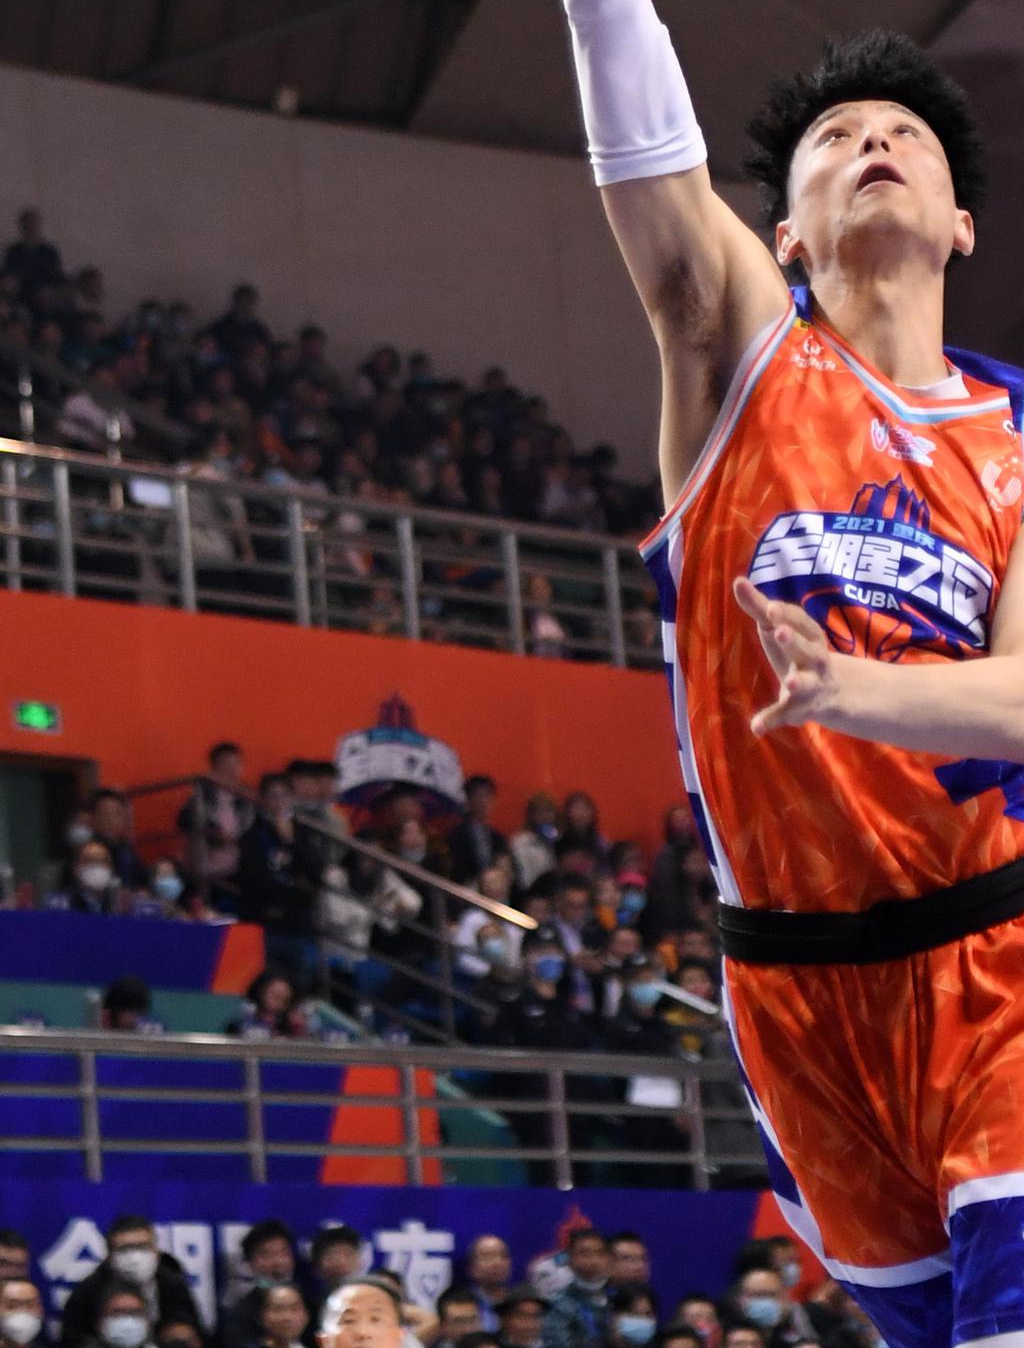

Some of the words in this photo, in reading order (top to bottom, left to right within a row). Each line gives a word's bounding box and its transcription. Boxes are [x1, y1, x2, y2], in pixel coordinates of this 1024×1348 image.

[832, 515, 886, 533] 2021
[748, 512, 994, 646] 全明星之夜
[843, 583, 900, 611] CUBA
